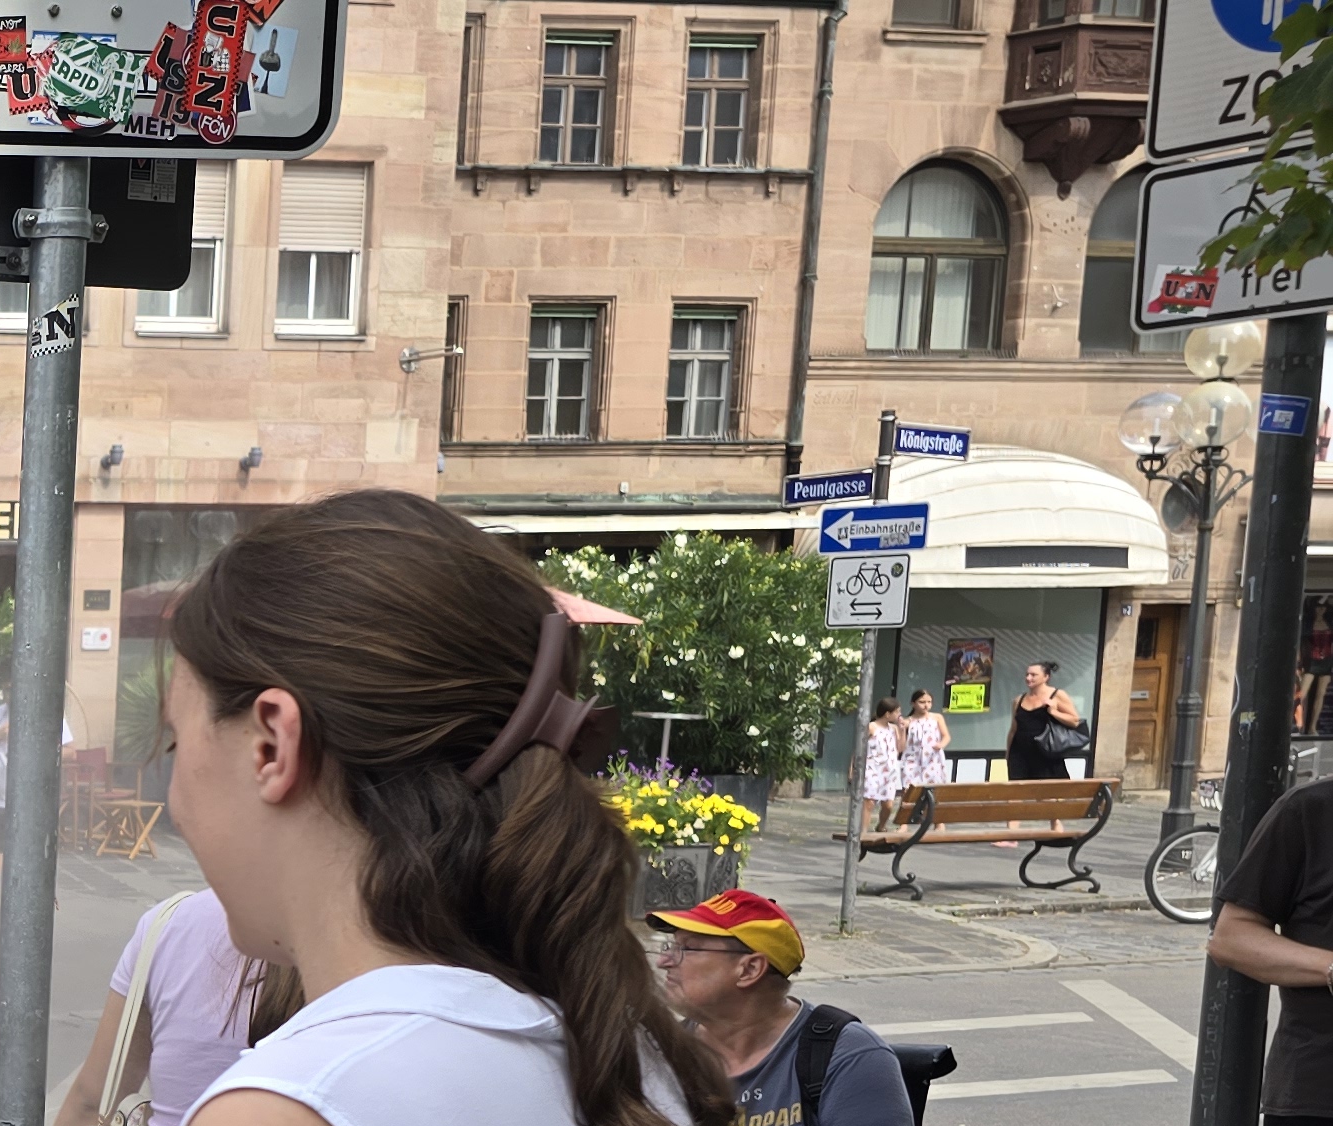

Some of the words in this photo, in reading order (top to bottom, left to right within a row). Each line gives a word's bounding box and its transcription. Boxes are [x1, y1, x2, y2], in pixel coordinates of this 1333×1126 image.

[51, 55, 100, 92] RAPID
[123, 115, 176, 137] MEH
[899, 430, 964, 454] Königstraße
[793, 479, 867, 500] Peuntgasse
[849, 520, 921, 536] Einbahnstraße
